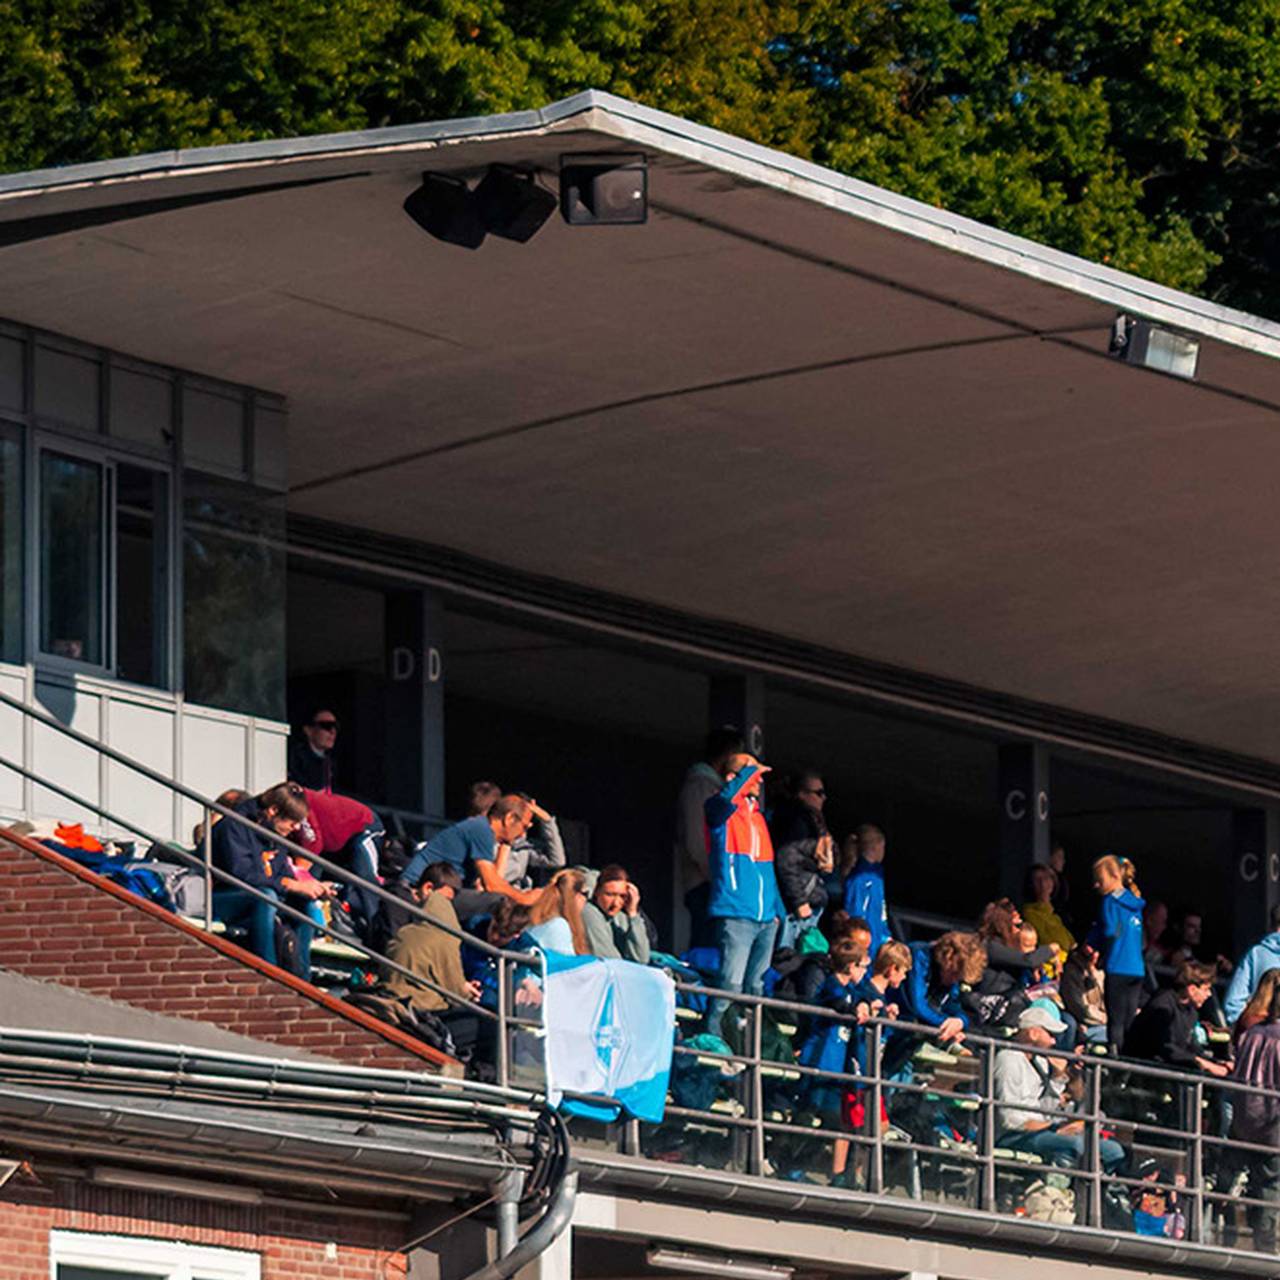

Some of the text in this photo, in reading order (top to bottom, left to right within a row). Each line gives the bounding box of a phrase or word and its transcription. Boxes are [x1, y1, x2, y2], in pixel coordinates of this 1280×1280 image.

[393, 647, 415, 681] D
[428, 647, 441, 682] D
[1005, 789, 1026, 821] C
[1037, 790, 1048, 822] C
[1239, 852, 1259, 882] C
[1269, 852, 1280, 882] C
